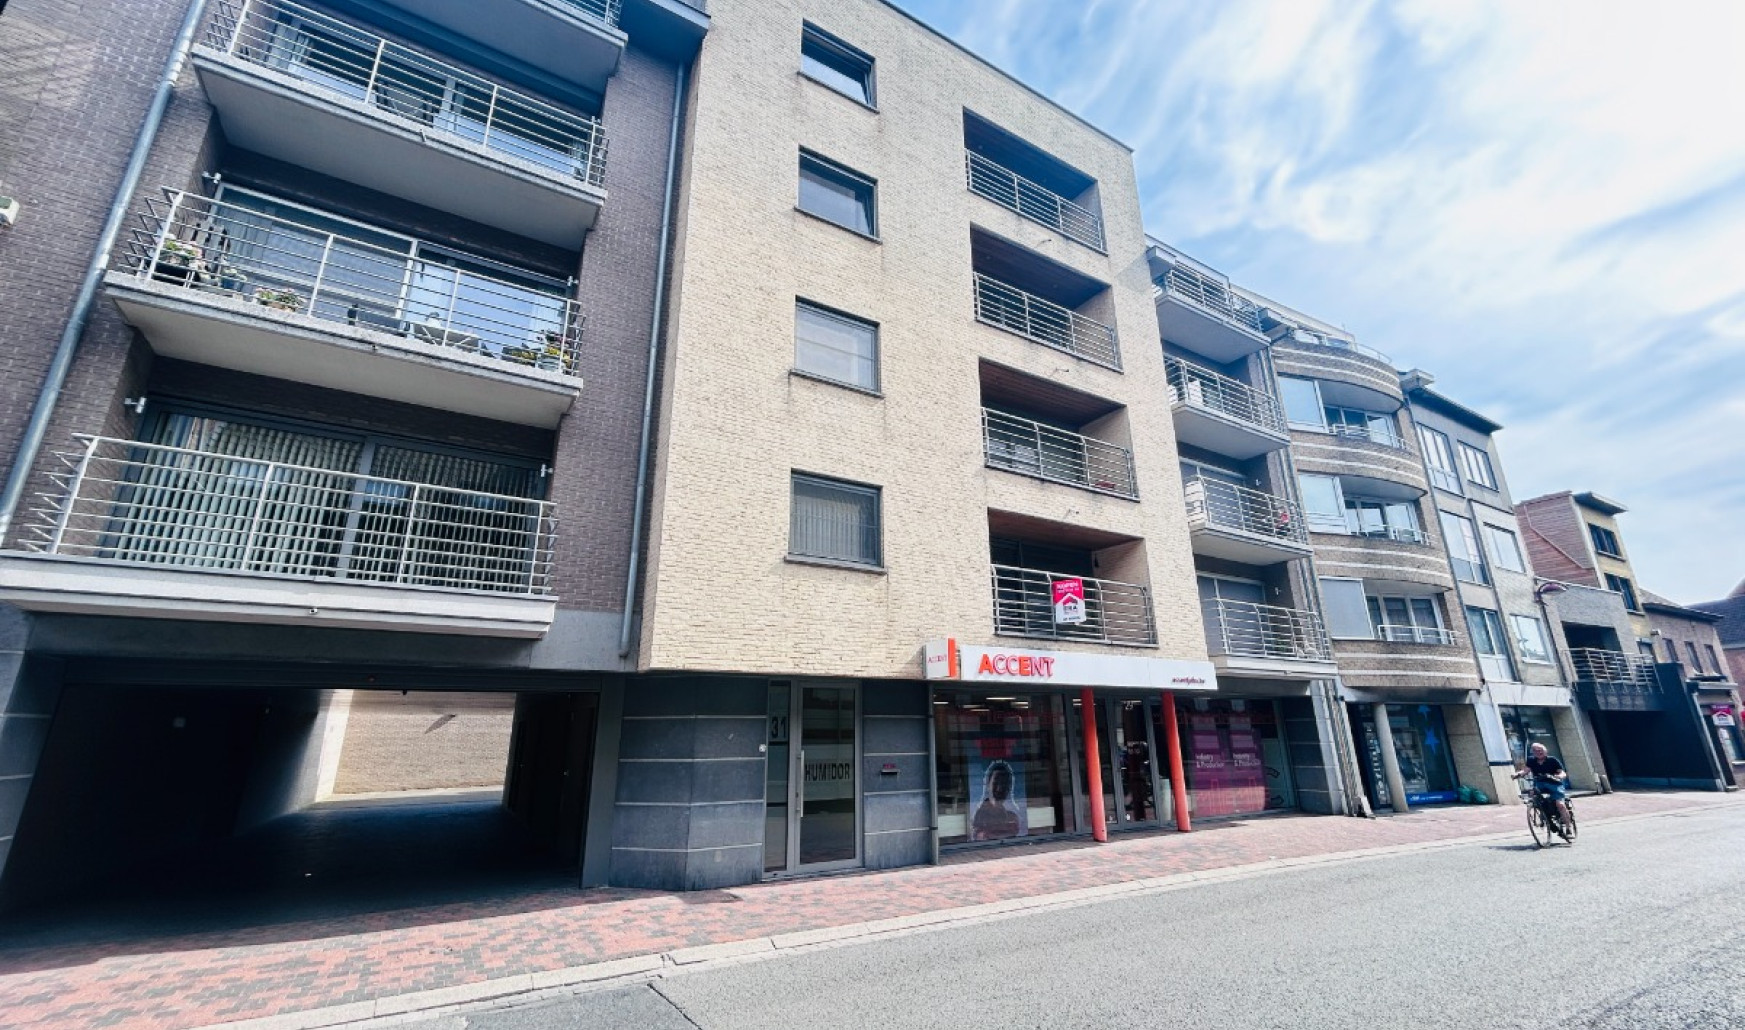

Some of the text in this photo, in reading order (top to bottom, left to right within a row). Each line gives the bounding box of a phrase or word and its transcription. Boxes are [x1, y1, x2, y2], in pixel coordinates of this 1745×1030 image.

[978, 653, 1055, 677] ACCENT
[771, 716, 787, 738] 31
[804, 762, 850, 781] HUMIDOR
